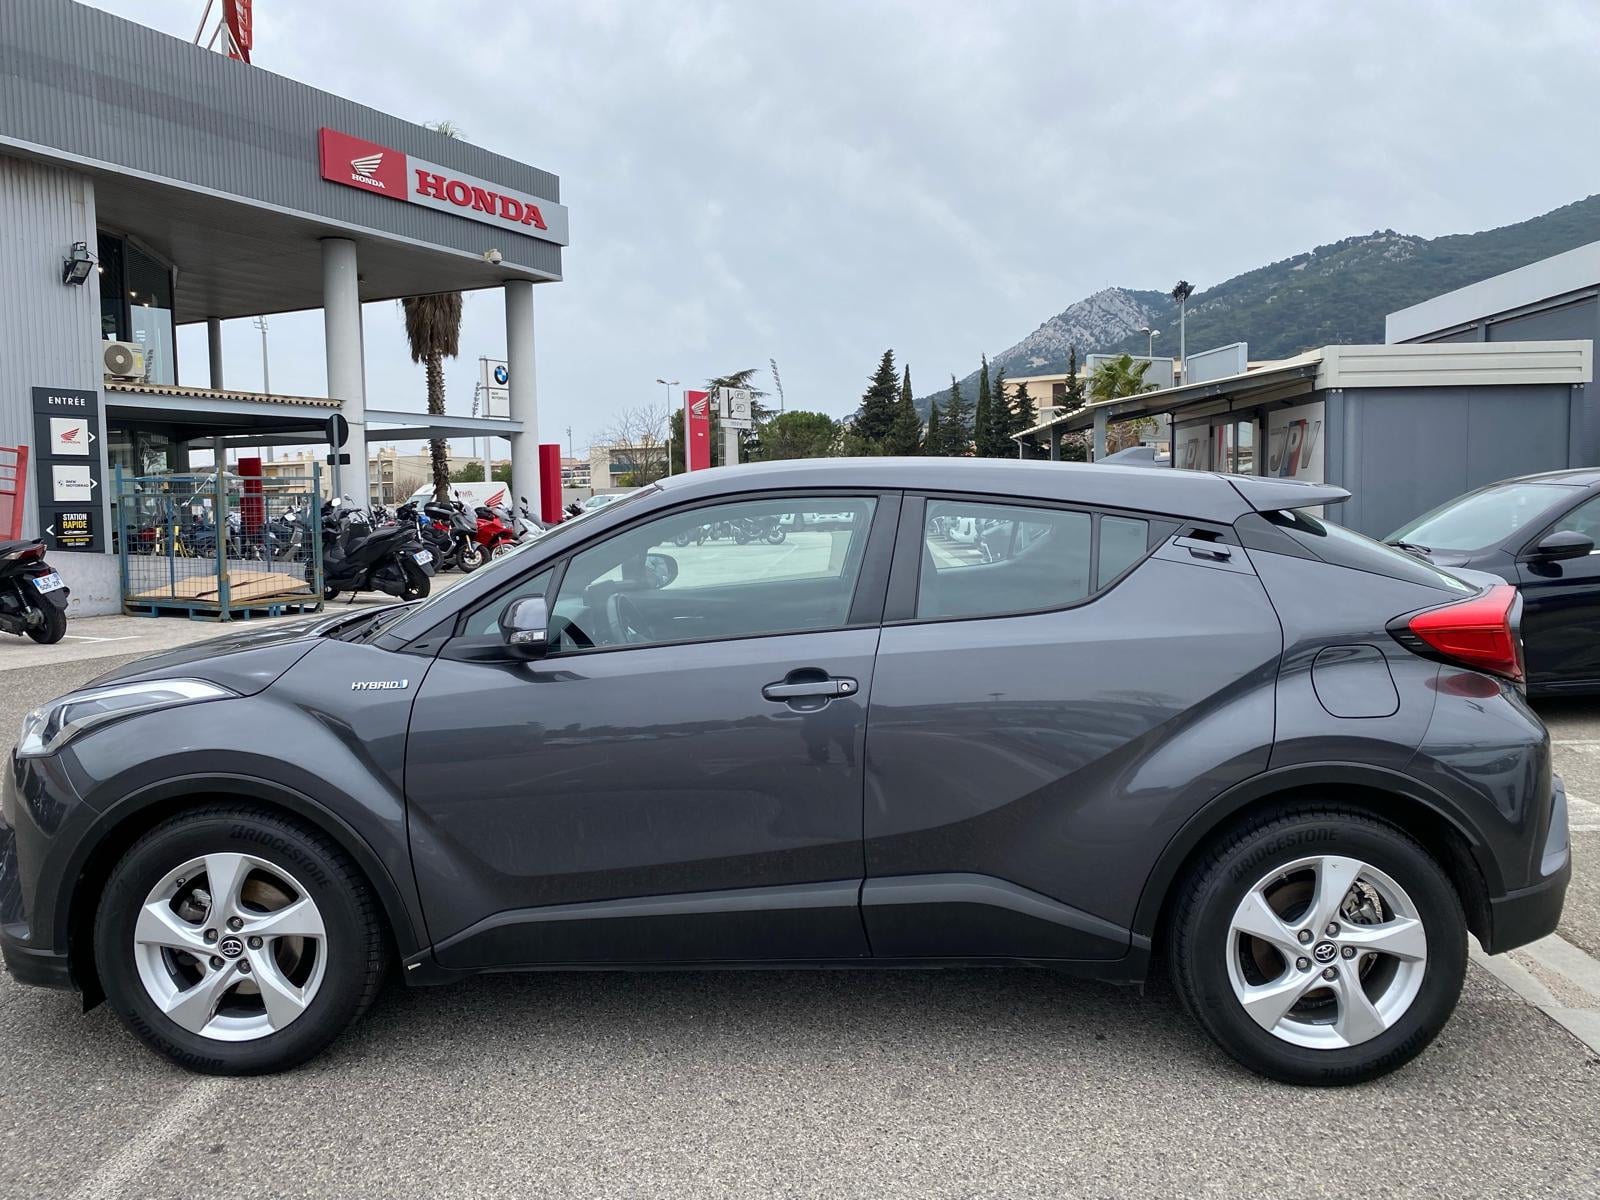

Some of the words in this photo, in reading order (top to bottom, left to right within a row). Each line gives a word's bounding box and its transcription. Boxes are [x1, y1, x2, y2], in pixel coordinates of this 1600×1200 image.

[351, 173, 386, 189] HONDA
[415, 168, 547, 231] HONDA
[48, 396, 86, 406] ENTRÉE
[62, 513, 88, 521] STATION
[62, 520, 88, 529] RAPIDE
[351, 680, 399, 690] HYBRID
[229, 824, 332, 889] BRIDGESTONE
[1228, 827, 1341, 883] BRIDGESTONE
